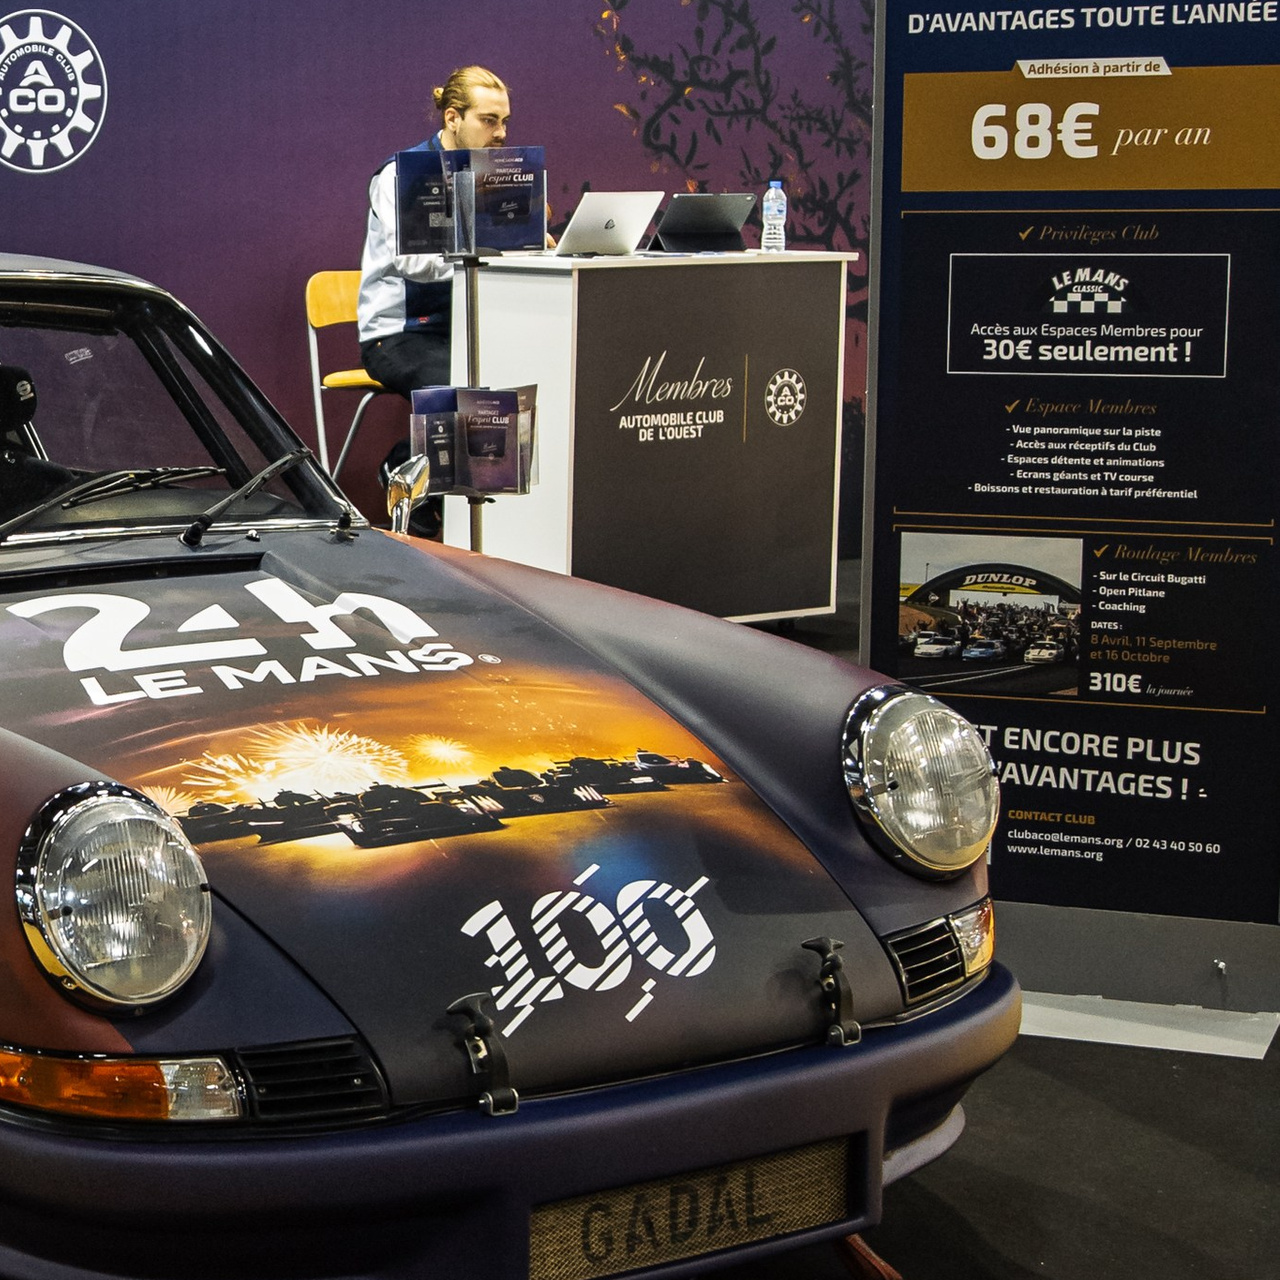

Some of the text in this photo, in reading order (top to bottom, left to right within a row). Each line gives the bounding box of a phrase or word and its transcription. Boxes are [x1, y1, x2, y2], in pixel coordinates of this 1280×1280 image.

[908, 7, 1075, 34] D'AVANTAGES
[1081, 5, 1165, 28] TOUTE
[55, 53, 76, 81] CLUB
[1027, 61, 1161, 76] Adhésion à partir de
[971, 102, 1212, 160] 68€ par an
[1039, 225, 1160, 245] Privilèges Club
[1051, 267, 1129, 291] LE MANS
[1072, 285, 1104, 293] CLASSIC
[970, 323, 1204, 340] Accès aux Espaces Membres pour
[982, 339, 1032, 361] 30€
[1038, 340, 1178, 362] seulement
[609, 350, 734, 411] Membres
[1025, 398, 1158, 417] Espace Membres
[619, 410, 725, 429] AUTOMOBILE CLUB
[639, 425, 704, 441] DE L'OUEST
[1012, 425, 1032, 435] Vue
[1033, 426, 1102, 438] panoramique
[1103, 427, 1120, 436] sur
[1122, 426, 1133, 436] la
[1134, 426, 1162, 439] piste
[1016, 440, 1046, 450] Accès
[1048, 442, 1066, 450] aux
[1069, 440, 1115, 453] réceptifs
[1117, 441, 1131, 451] du
[1133, 441, 1157, 452] Club
[1007, 455, 1049, 467] Espaces
[1051, 455, 1092, 466] détente
[1094, 457, 1104, 466] et
[1106, 457, 1165, 468] animations
[1017, 470, 1050, 480] Ecrans
[1053, 471, 1088, 483] géants
[1091, 472, 1101, 481] et
[1103, 472, 1117, 481] TV
[1119, 473, 1154, 483] course
[974, 483, 1020, 493] Boissons
[1022, 485, 1032, 494] et
[1034, 485, 1099, 496] restauration
[1101, 486, 1107, 496] à
[1109, 486, 1132, 497] tarif
[1134, 488, 1198, 499] préférentiel
[1115, 544, 1258, 565] Roulage Membres
[963, 573, 1037, 587] DUNLOP
[1100, 571, 1117, 580] Sur
[1119, 572, 1129, 581] le
[1131, 573, 1165, 582] Circuit
[1167, 574, 1206, 585] Bugatti
[1099, 586, 1126, 597] Open
[1128, 587, 1165, 598] Pitlane
[1098, 601, 1146, 613] Coaching
[1091, 621, 1118, 629] DATES
[1090, 635, 1098, 644] 8
[1135, 636, 1146, 646] 11
[1149, 638, 1217, 650] Septembre
[1090, 650, 1170, 663] et 16 Octobre
[79, 669, 203, 706] LE
[1089, 672, 1194, 697] 310€ la journée
[1004, 726, 1118, 759] ENCORE
[1127, 738, 1201, 766] PLUS
[1008, 810, 1096, 825] CONTACT CLUB
[1008, 829, 1123, 848] clubaco@lemans.org
[1135, 838, 1150, 849] 02
[1152, 839, 1167, 850] 43
[1170, 841, 1186, 851] 40
[1188, 842, 1203, 852] 50
[1205, 843, 1221, 854] 60
[1007, 844, 1104, 861] www.lemans.org
[580, 1167, 778, 1264] GADAL
